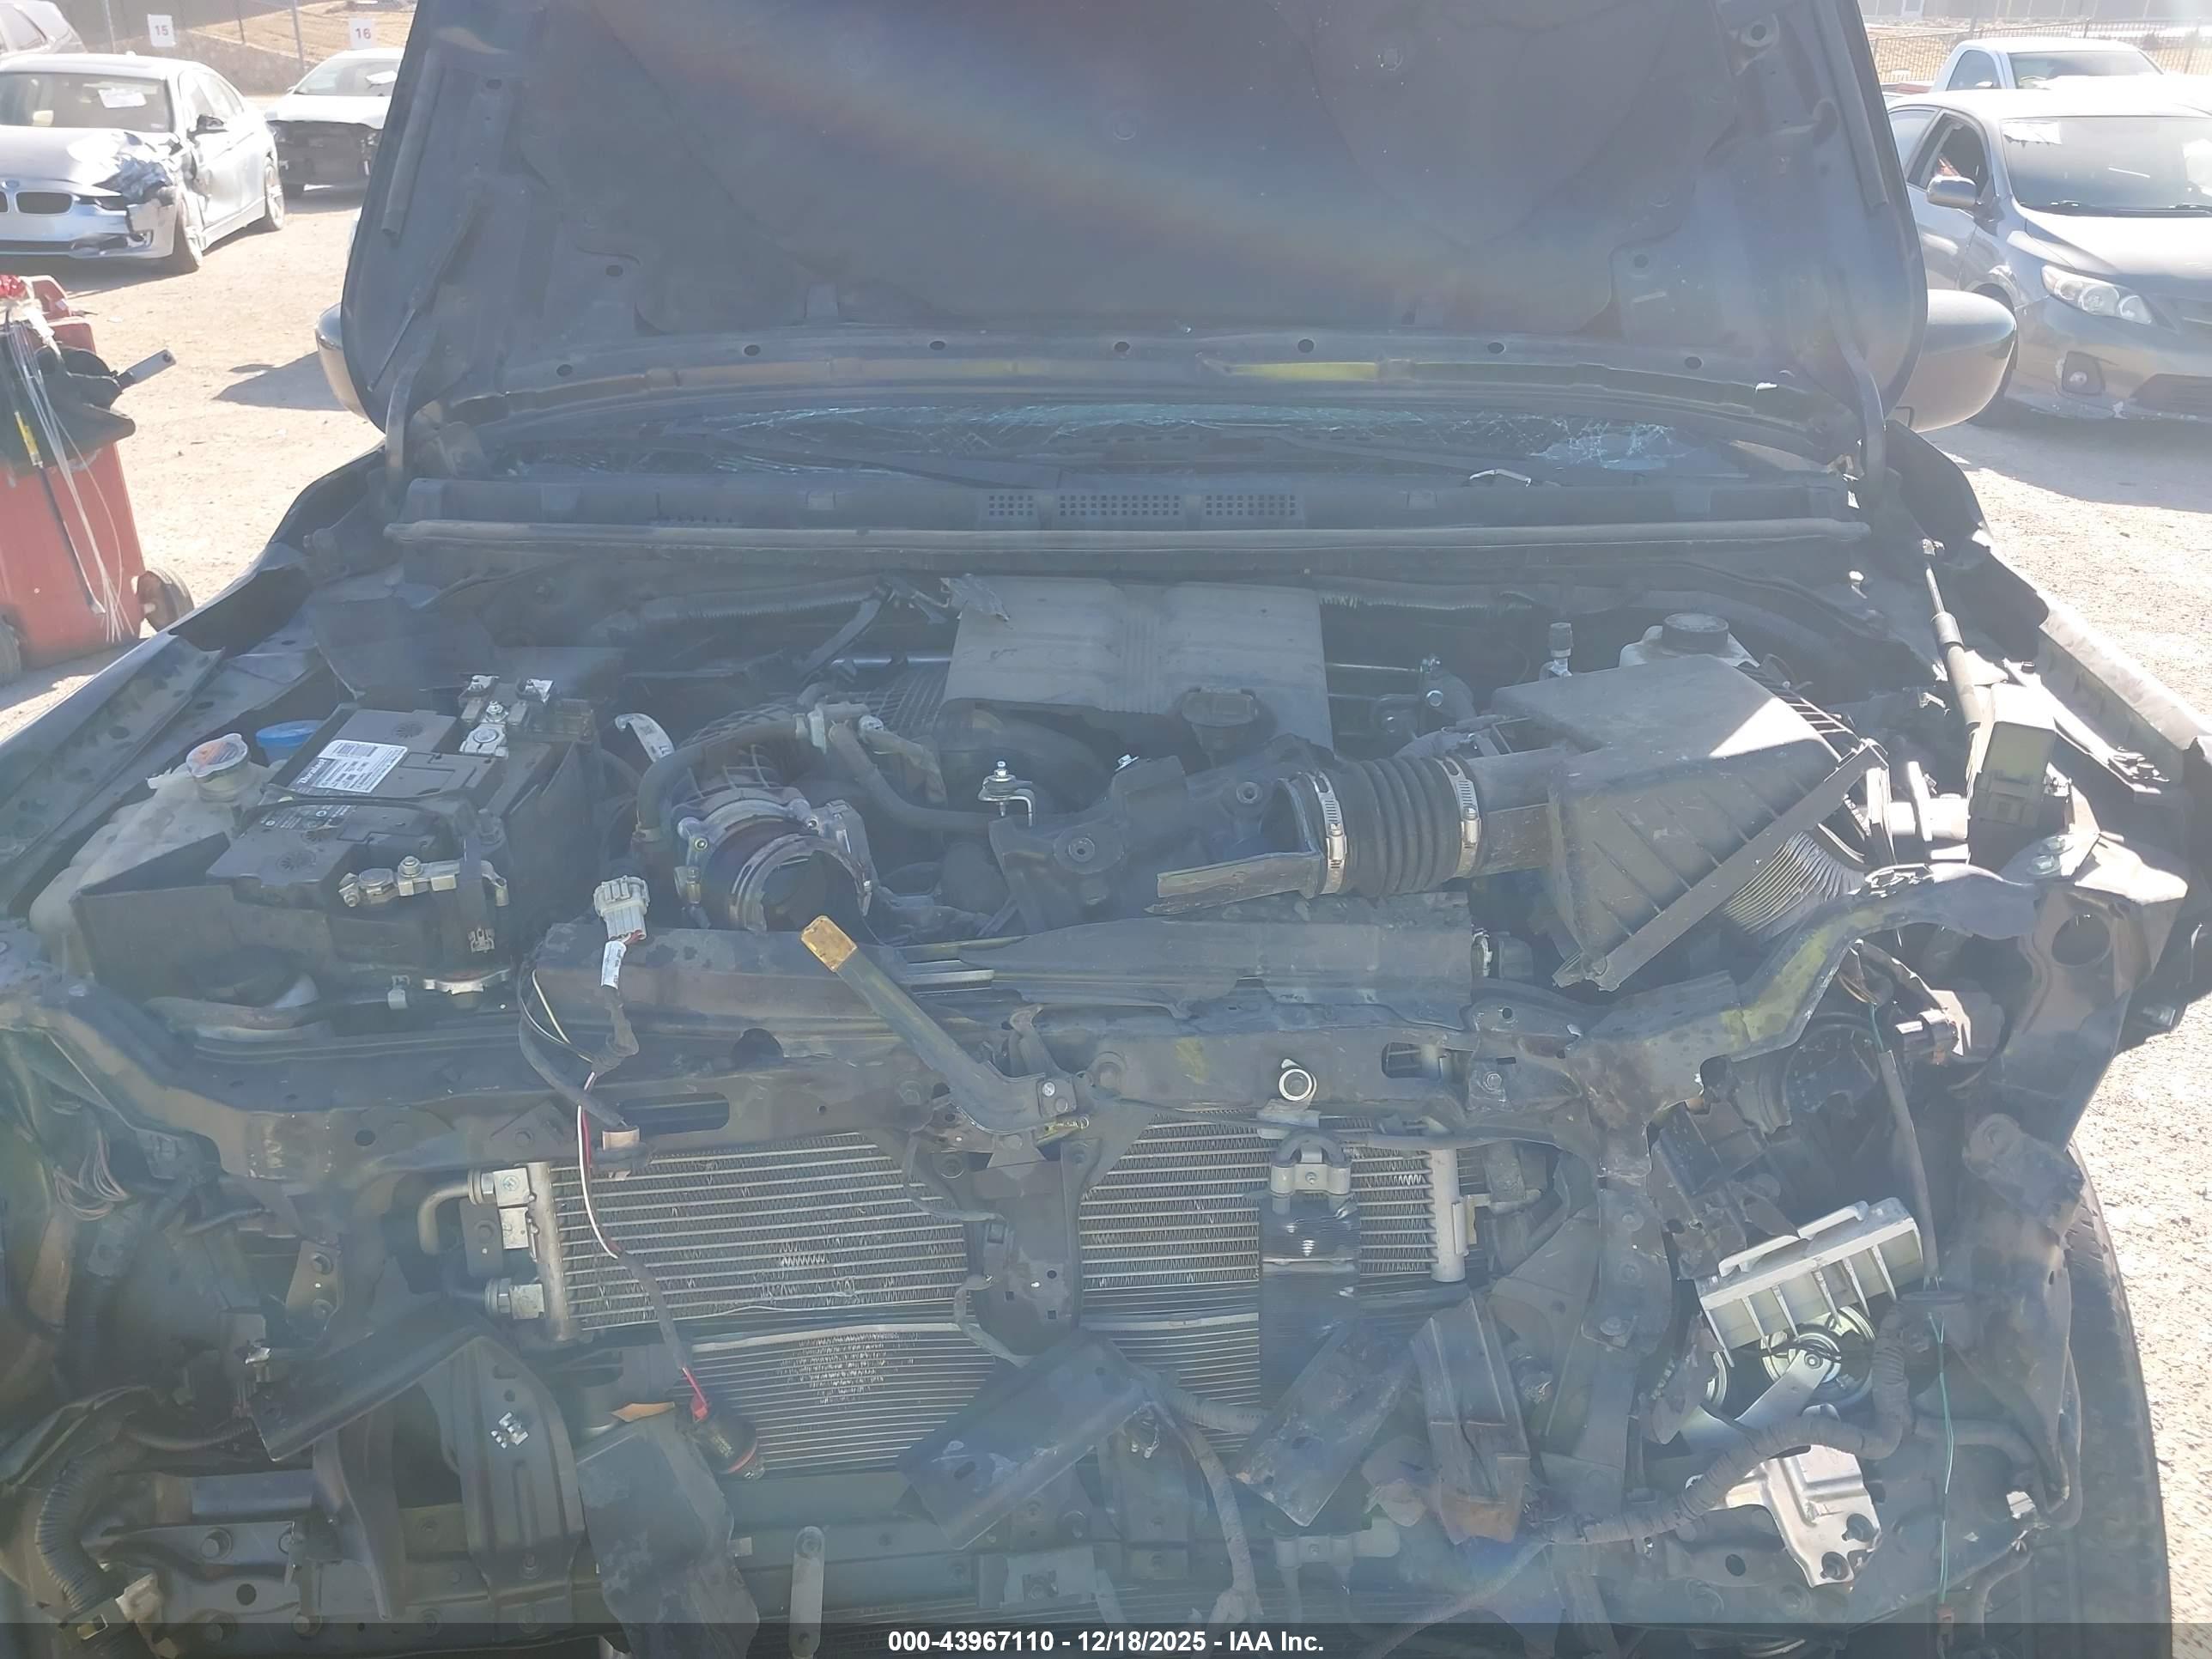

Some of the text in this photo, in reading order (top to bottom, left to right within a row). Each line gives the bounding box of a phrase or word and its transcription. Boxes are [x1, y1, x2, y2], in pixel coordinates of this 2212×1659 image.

[155, 25, 169, 36] 15
[355, 27, 372, 40] 16
[296, 758, 327, 785] Duralast
